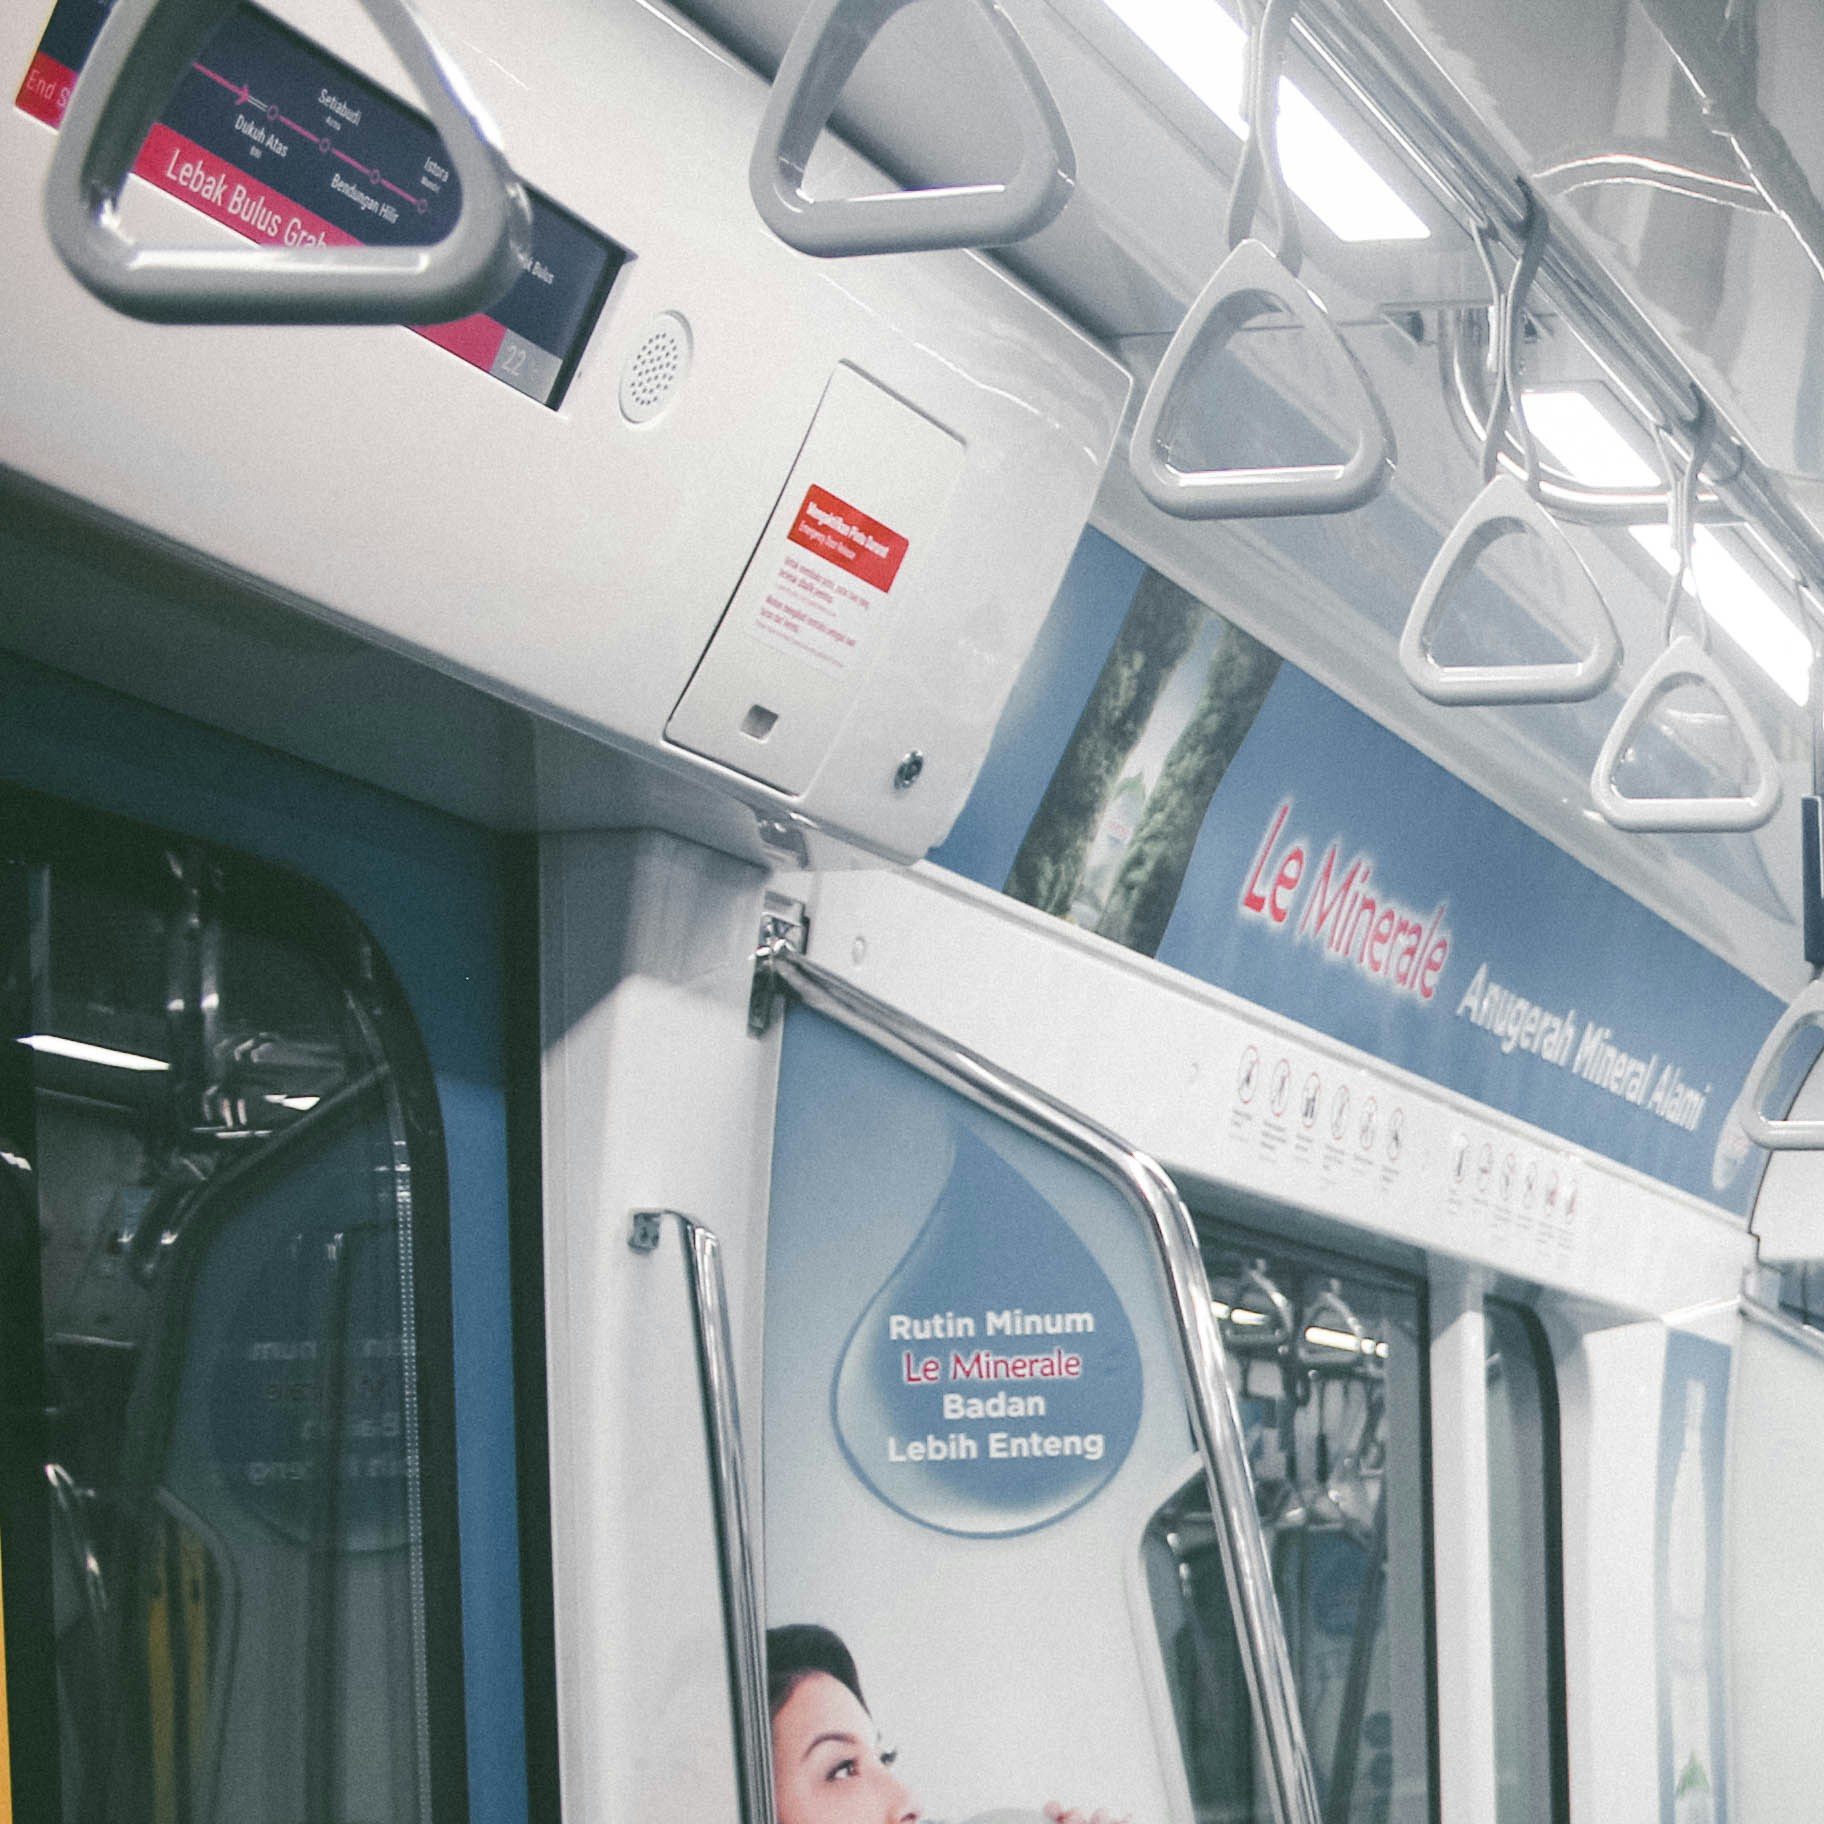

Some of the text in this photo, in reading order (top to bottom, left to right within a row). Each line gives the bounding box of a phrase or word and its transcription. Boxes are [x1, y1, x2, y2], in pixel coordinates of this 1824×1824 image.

[235, 115, 289, 157] Dukuh Atas
[167, 149, 225, 206] Lebak
[228, 184, 282, 237] Bulus
[1242, 803, 1710, 1134] Le Minerale Anugerah Mineral Alami
[889, 1309, 1094, 1340] Rutin Minum
[905, 1348, 1082, 1383] Le Minerale
[943, 1392, 1046, 1419] Badan
[888, 1432, 1105, 1462] Lebih Enteng
